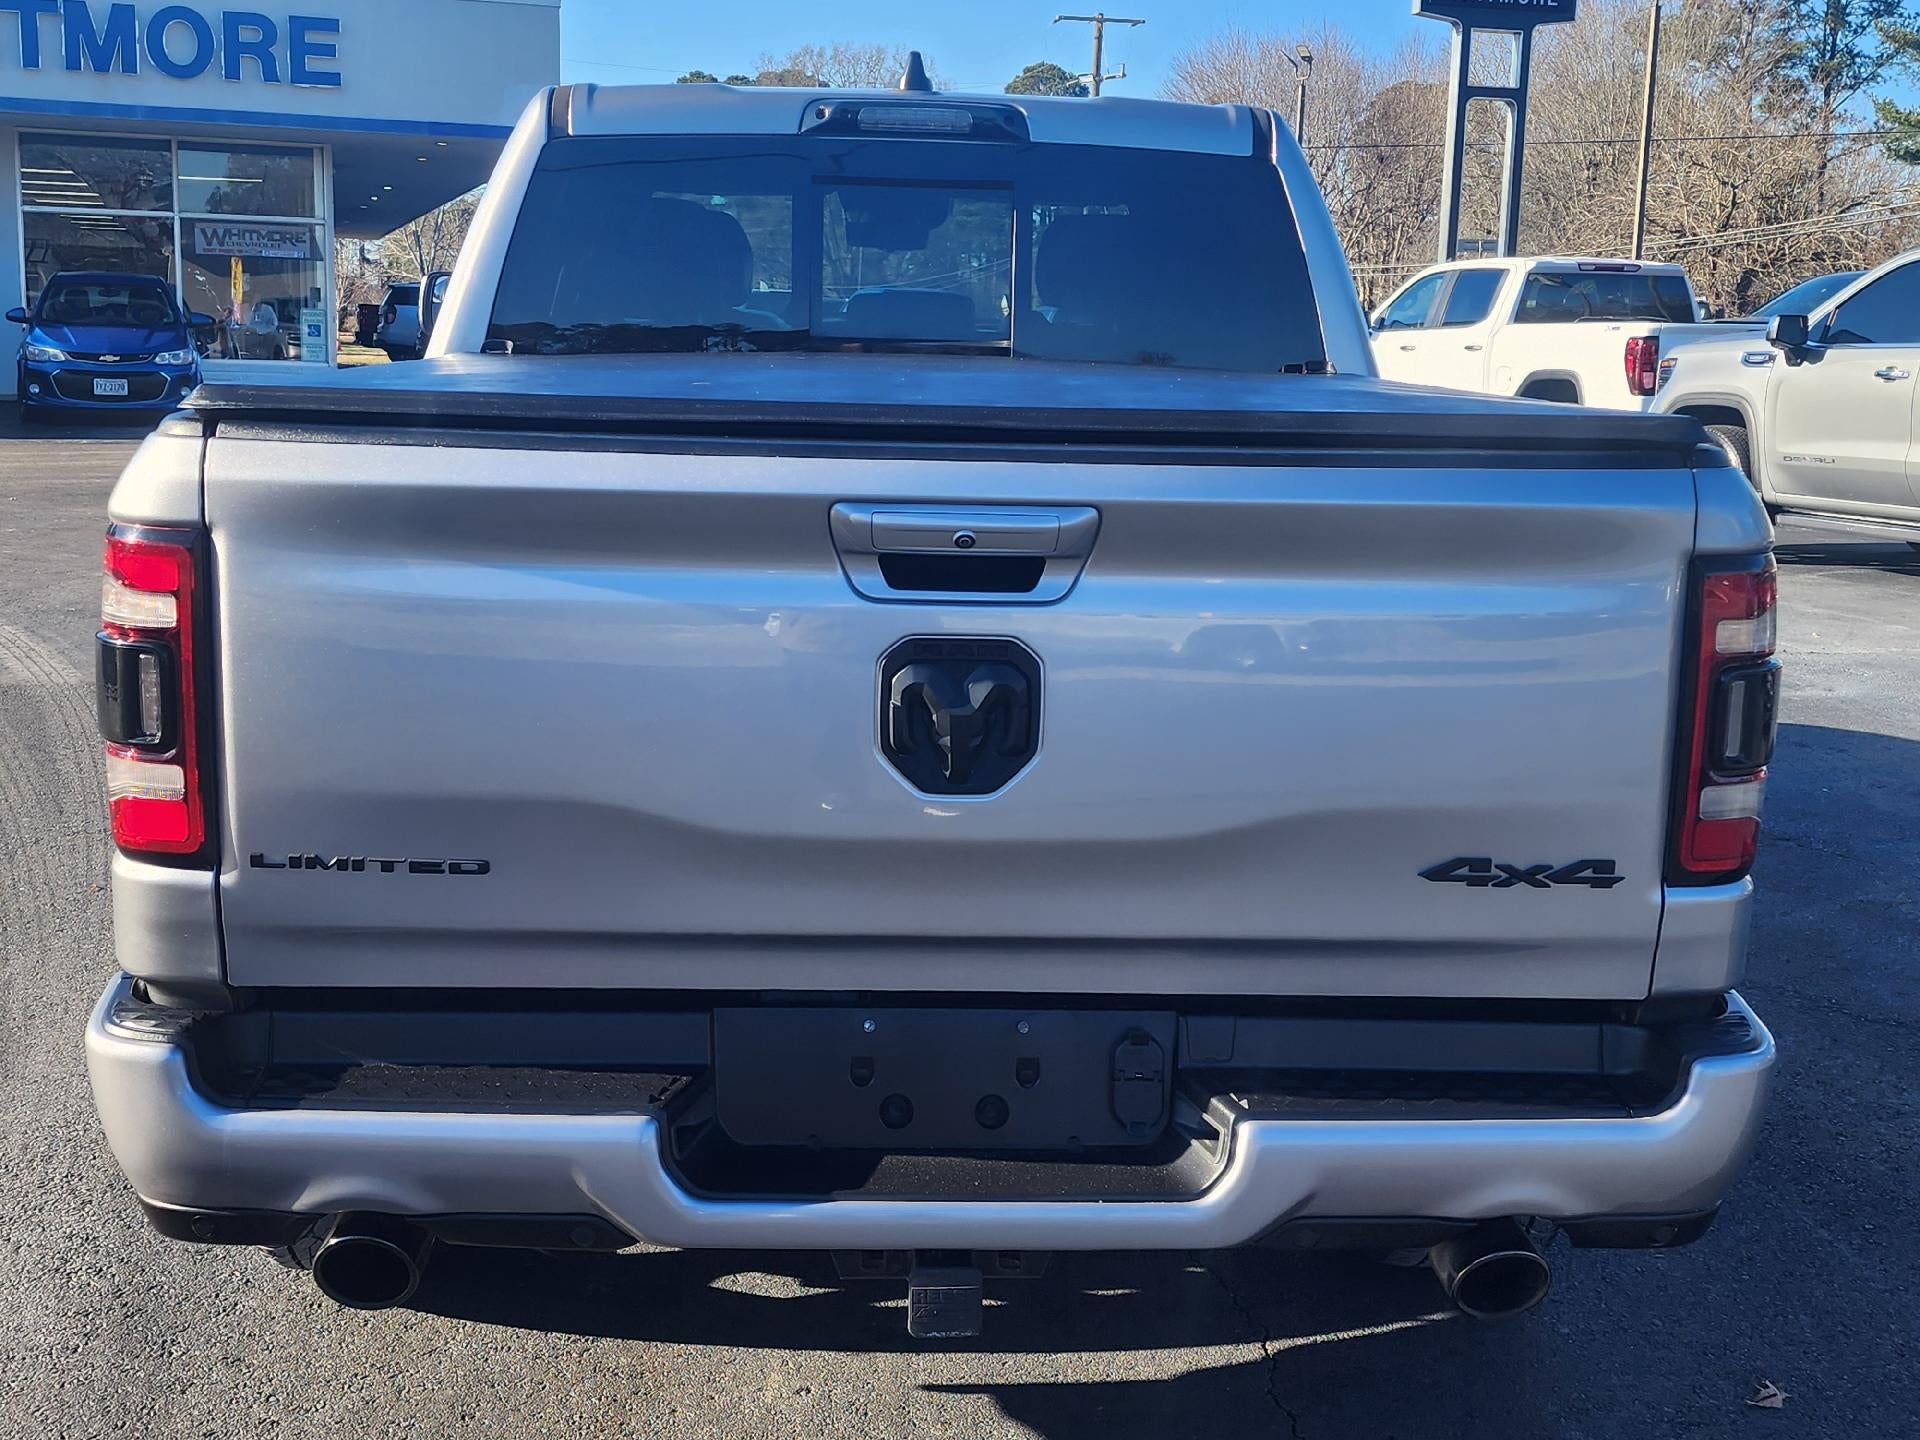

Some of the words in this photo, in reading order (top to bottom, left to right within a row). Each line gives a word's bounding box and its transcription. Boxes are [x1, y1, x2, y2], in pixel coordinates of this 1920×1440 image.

[0, 0, 342, 87] TMORE
[199, 226, 307, 247] WHITMORE
[225, 240, 282, 250] CHEVROLET
[249, 852, 491, 875] LIMITED
